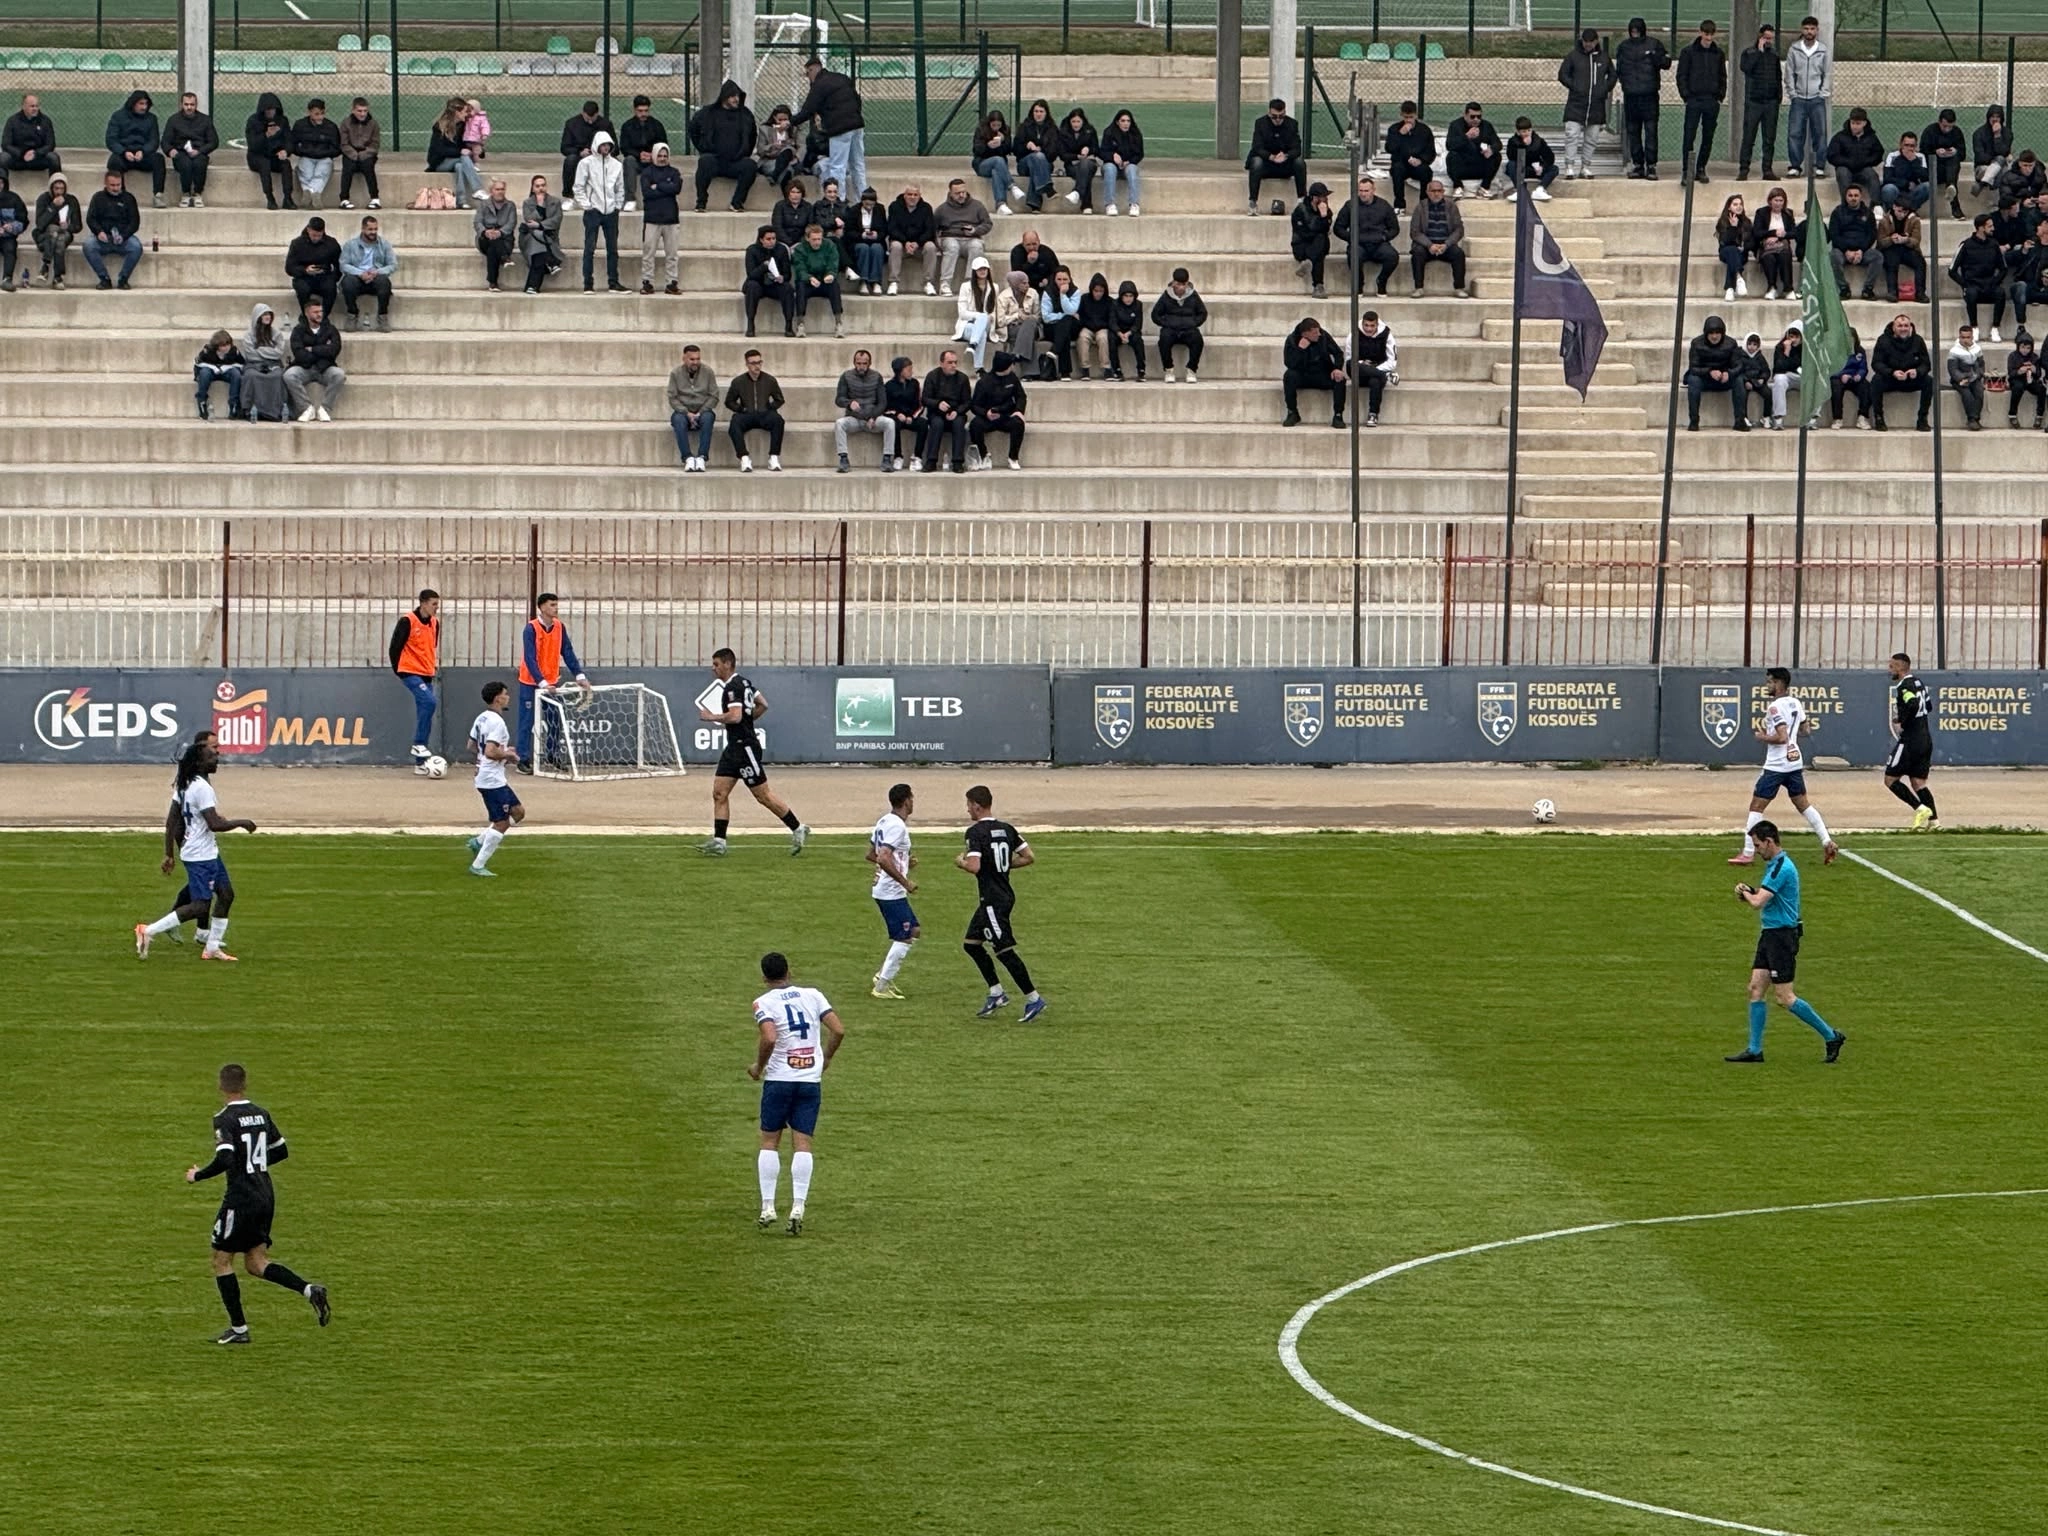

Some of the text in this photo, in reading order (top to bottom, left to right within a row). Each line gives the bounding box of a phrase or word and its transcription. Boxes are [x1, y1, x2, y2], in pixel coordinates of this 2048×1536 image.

[1145, 686, 1234, 698] FEDERATA E
[1335, 684, 1424, 696] FEDERATA E
[1528, 683, 1616, 695] FEDERATA E
[1751, 686, 1839, 698] FERATA E
[1939, 687, 2027, 700] FEDERATA E
[901, 697, 963, 717] TEB
[1145, 700, 1238, 713] FUTBOLLIT E
[1335, 698, 1428, 711] FUTBOLLIT E
[1528, 697, 1621, 710] FUTBOLLIT E
[1835, 701, 1844, 714] E
[1939, 702, 2032, 715] FUTBOLLIT E
[51, 702, 178, 737] KEDS
[1145, 714, 1215, 729] KOSOVËS
[1335, 712, 1404, 727] KOSOVËS
[1528, 711, 1597, 726] KOSOVËS
[1789, 711, 1798, 738] 7
[1939, 715, 2007, 731] KOSOVËS
[269, 717, 369, 745] MALL
[836, 742, 945, 750] BNP PARIBAS JOINT VENTURE
[739, 766, 754, 779] 99
[990, 842, 1010, 873] 10
[785, 1004, 810, 1040] 4
[241, 1131, 267, 1174] 14
